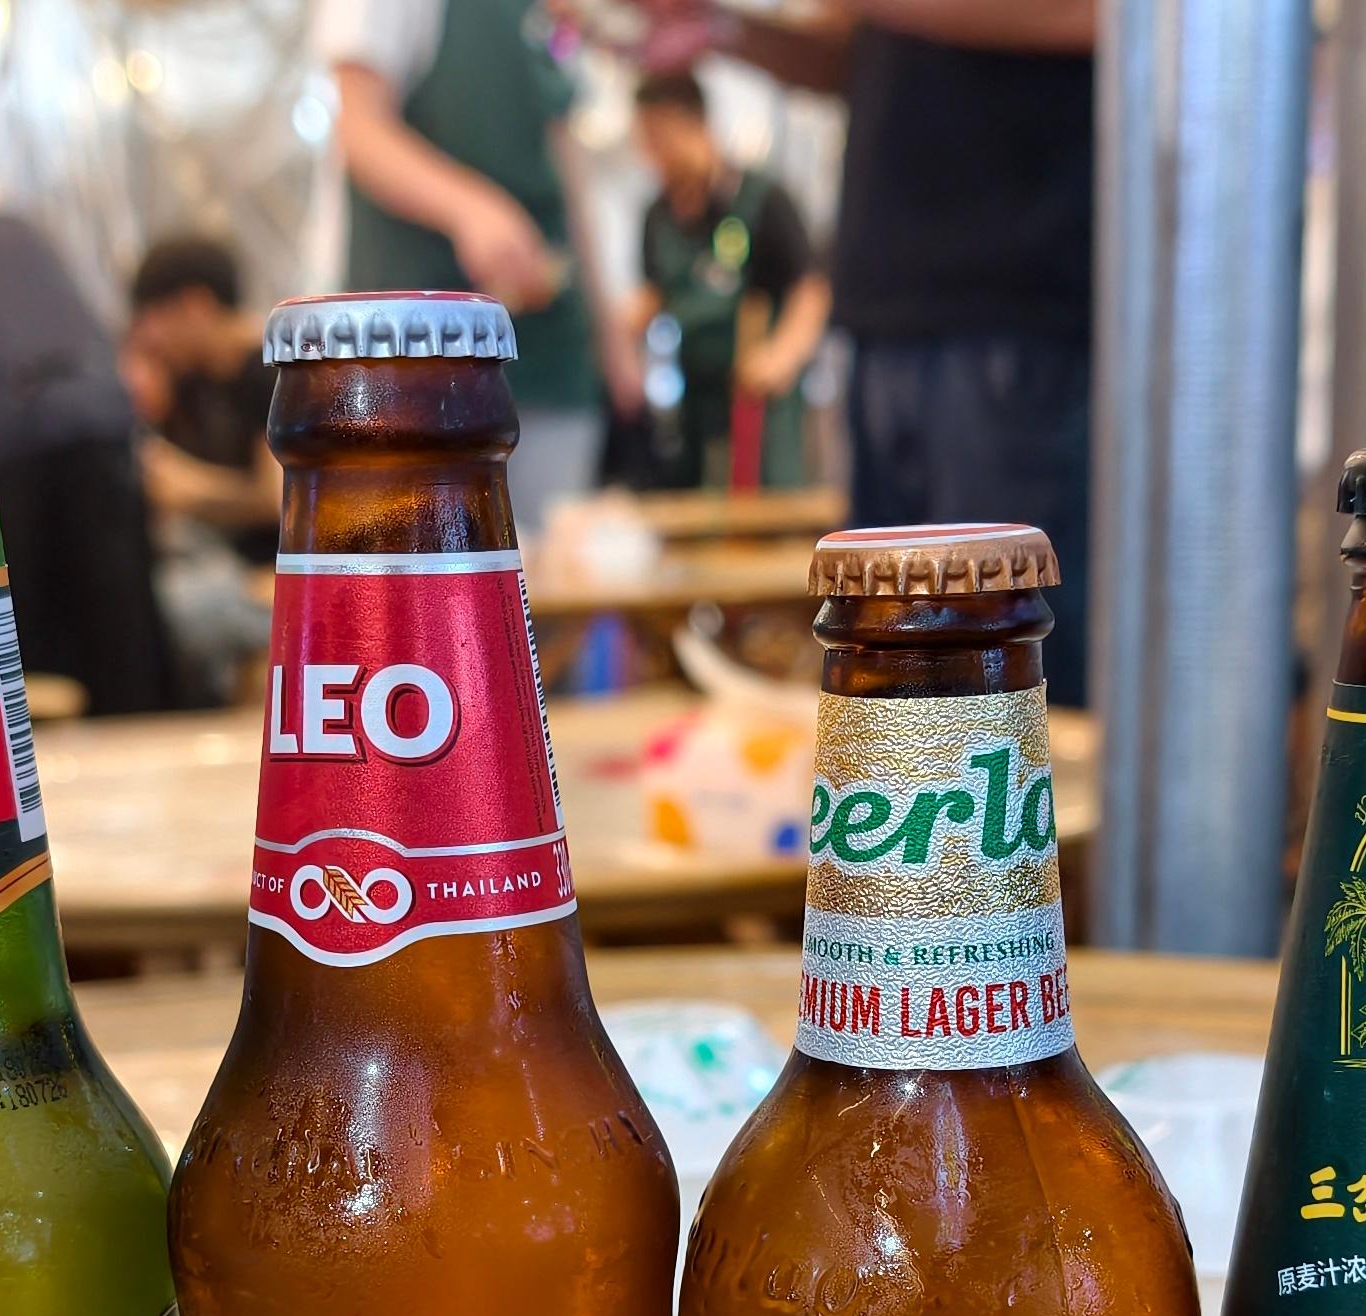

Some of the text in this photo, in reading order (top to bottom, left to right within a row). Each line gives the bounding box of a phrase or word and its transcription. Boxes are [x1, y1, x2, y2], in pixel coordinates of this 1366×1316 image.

[269, 663, 457, 762] LEO
[268, 876, 285, 894] OF
[426, 868, 542, 899] THAILAND
[882, 943, 902, 967] &
[912, 930, 1056, 967] REFRESHING
[899, 981, 1045, 1040] LAGER
